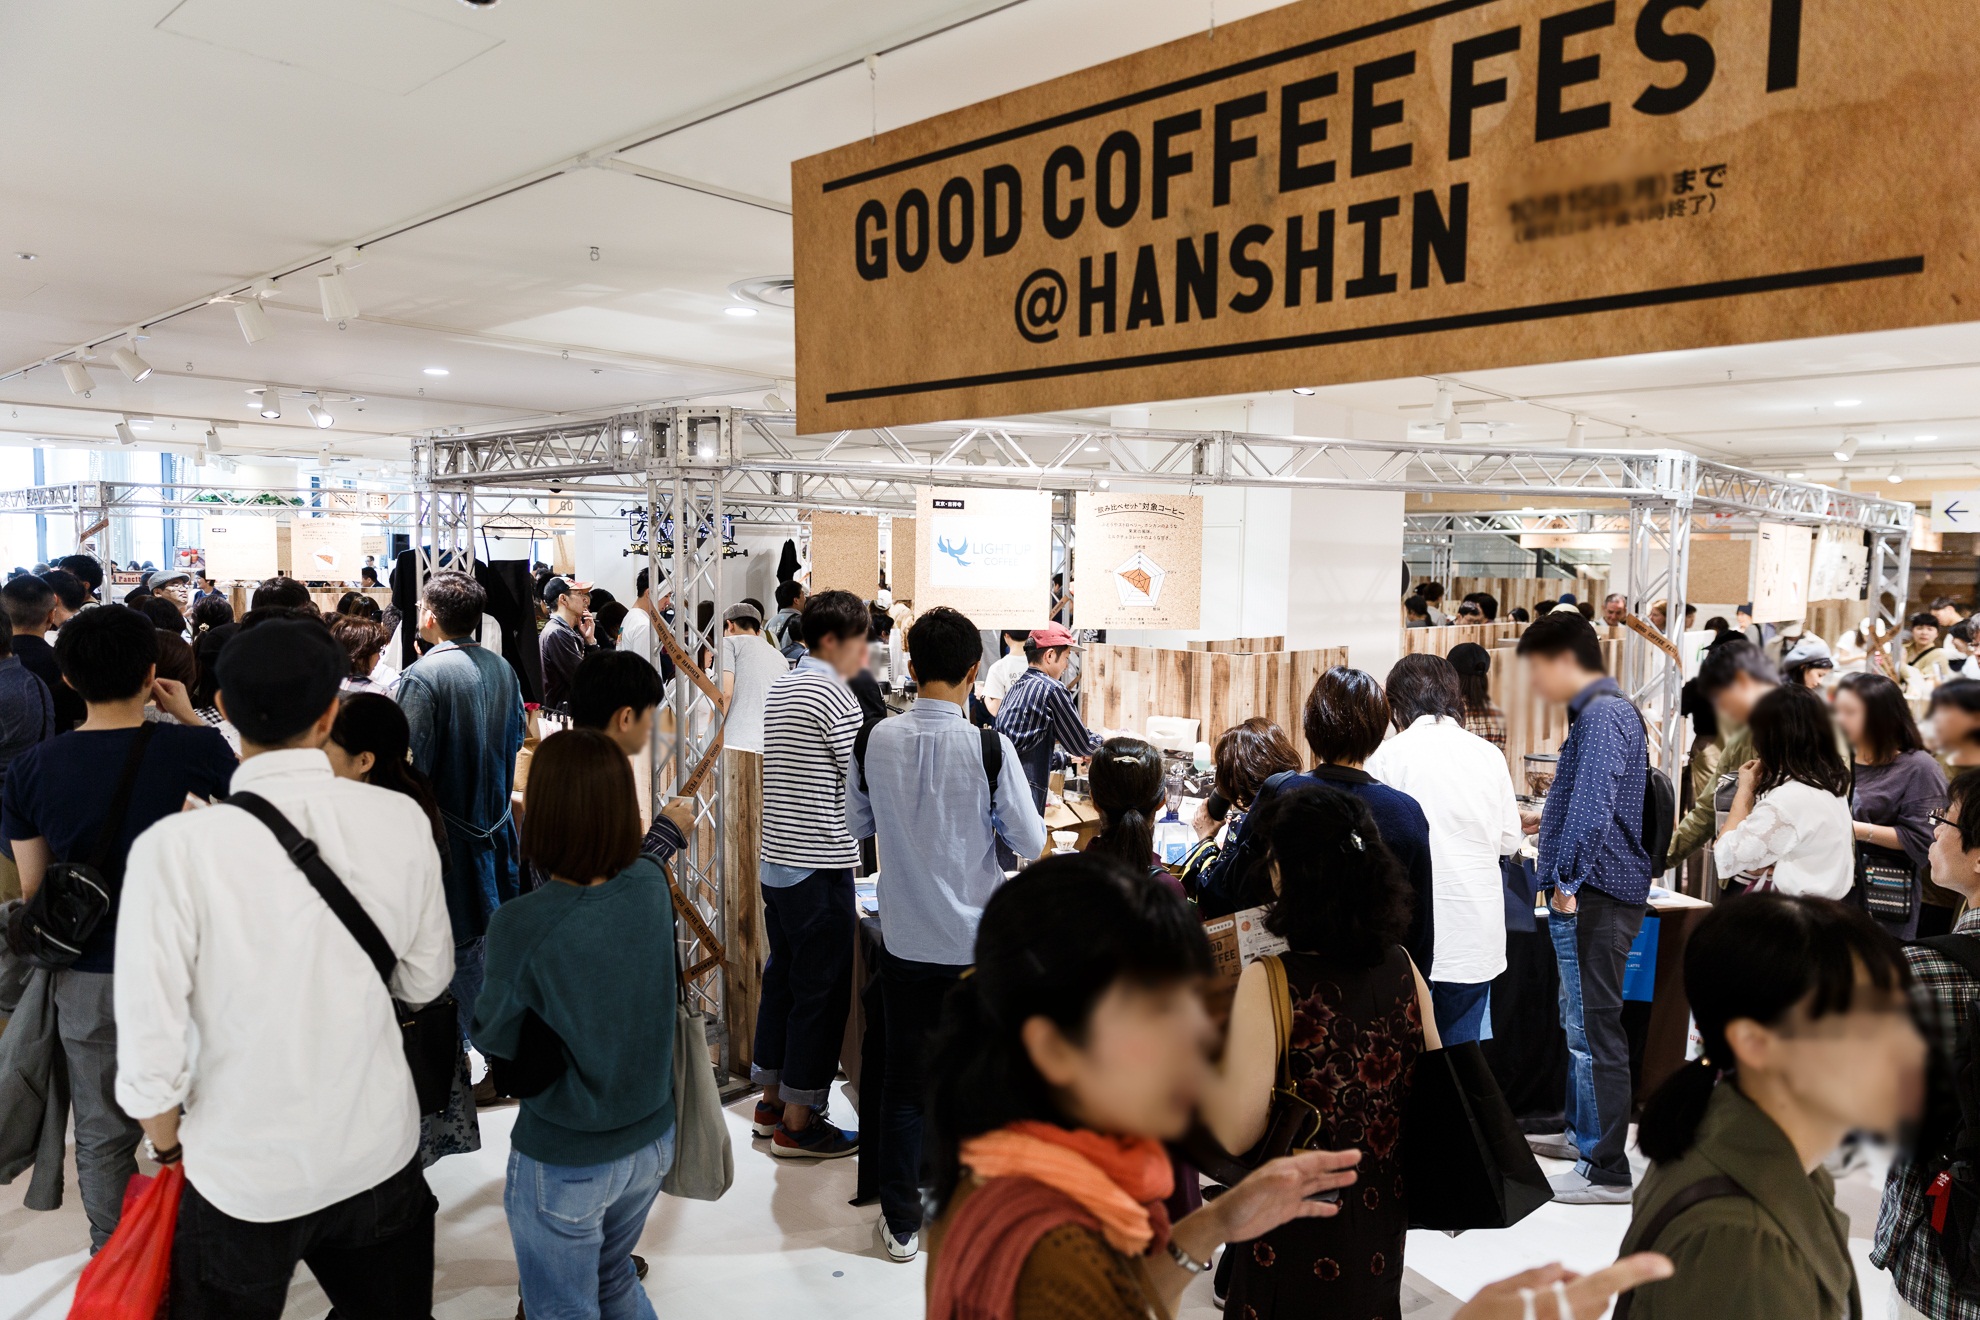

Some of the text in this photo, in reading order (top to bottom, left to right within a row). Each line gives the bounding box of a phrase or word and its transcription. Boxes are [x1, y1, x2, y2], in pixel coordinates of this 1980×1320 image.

[854, 163, 1022, 282] GOOD
[1043, 51, 1416, 240] COFFEE
[1014, 183, 1469, 344] @HANSHIN
[686, 743, 720, 795] GOOD COFFEE FEST
[674, 893, 685, 907] GOOD
[684, 907, 698, 924] COFFEE
[697, 924, 707, 936] FEST
